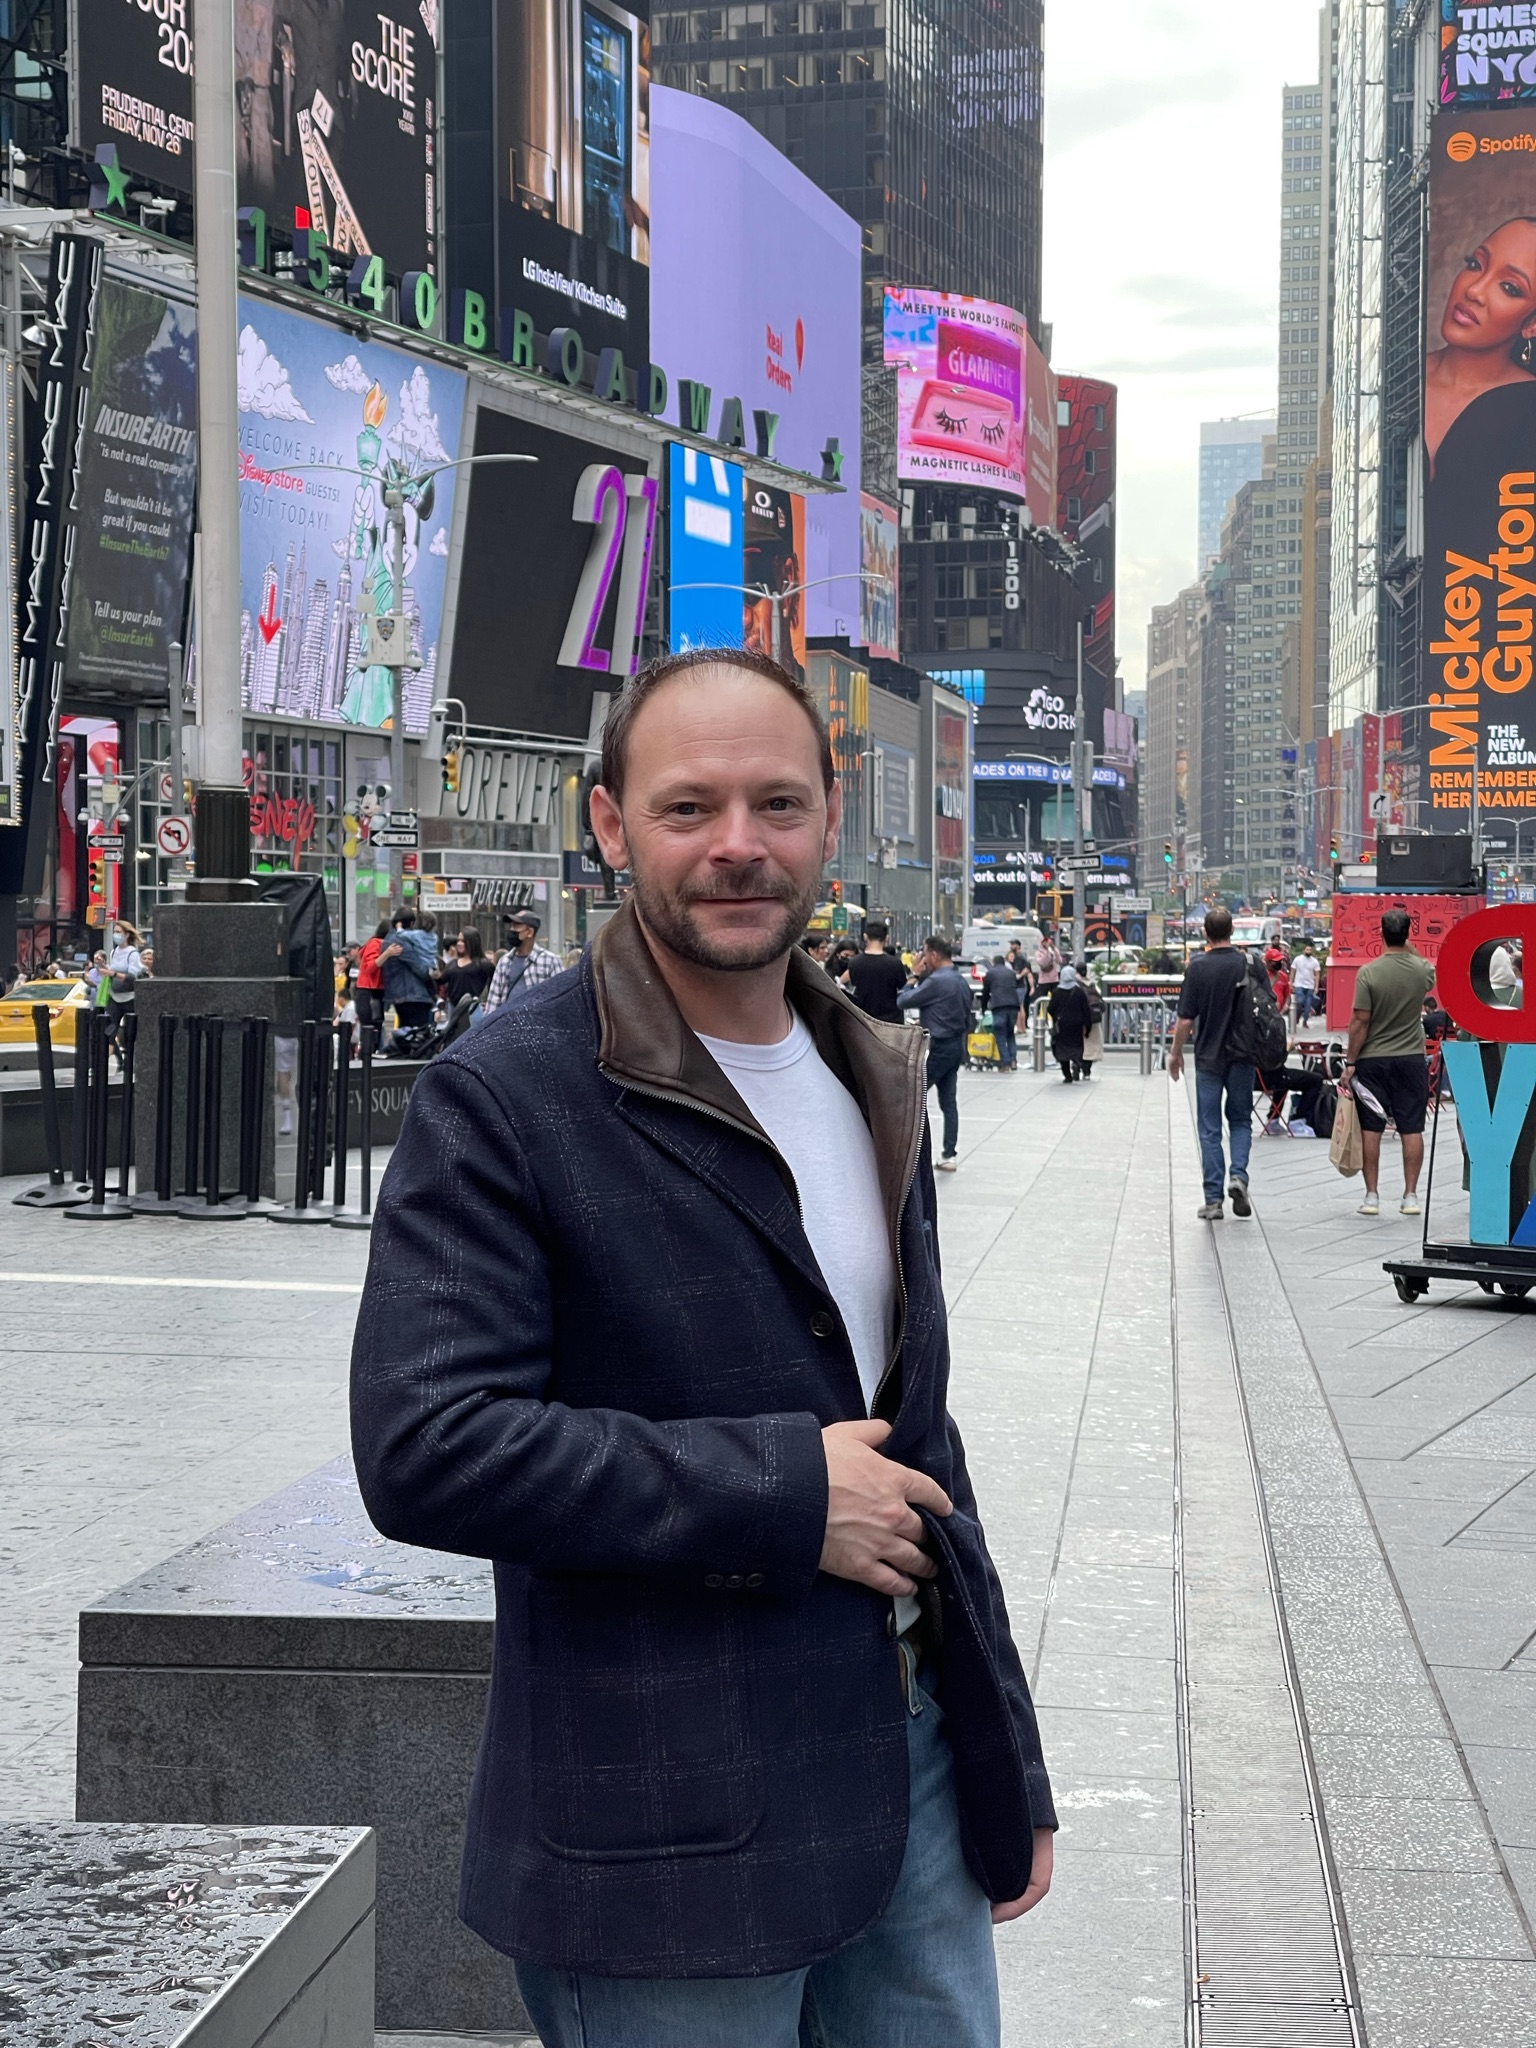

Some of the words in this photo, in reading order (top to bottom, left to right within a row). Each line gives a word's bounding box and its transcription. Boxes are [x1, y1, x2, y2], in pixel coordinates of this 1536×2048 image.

[158, 22, 193, 76] 20
[377, 13, 416, 69] THE
[351, 41, 416, 109] SCORE
[102, 84, 168, 131] PRUDENTIAL
[102, 105, 142, 143] FRIDAY,
[142, 121, 164, 149] NOV
[166, 131, 181, 155] 26
[522, 256, 536, 281] LG
[574, 279, 605, 311] Kitchen
[605, 294, 627, 320] Suite
[902, 302, 934, 315] MEET
[936, 306, 957, 318] THE
[958, 309, 999, 327] WORLD'S
[766, 322, 782, 358] Real
[766, 355, 792, 398] Orders
[131, 452, 149, 467] real
[910, 456, 969, 473] MAGNETIC
[970, 462, 1001, 478] LASHES
[104, 488, 119, 505] But
[161, 502, 172, 517] be
[273, 473, 304, 493] store
[305, 481, 340, 503] GUESTS!
[102, 514, 125, 528] great
[133, 520, 148, 533] you
[148, 521, 171, 538] could
[558, 464, 659, 677] 21
[1005, 541, 1020, 610] 1500
[1481, 471, 1536, 694] Guyton
[94, 600, 110, 618] Tell
[110, 608, 121, 620] us
[120, 610, 143, 625] your
[142, 609, 163, 628] plan
[1429, 550, 1494, 767] Mickey
[1487, 725, 1519, 739] THE
[1487, 738, 1526, 752] NEW
[1007, 764, 1026, 777] ON
[1432, 791, 1472, 809] HER
[1477, 790, 1536, 808] NAME
[996, 870, 1015, 883] out
[472, 880, 520, 907] FOREVER
[1137, 984, 1155, 995] too
